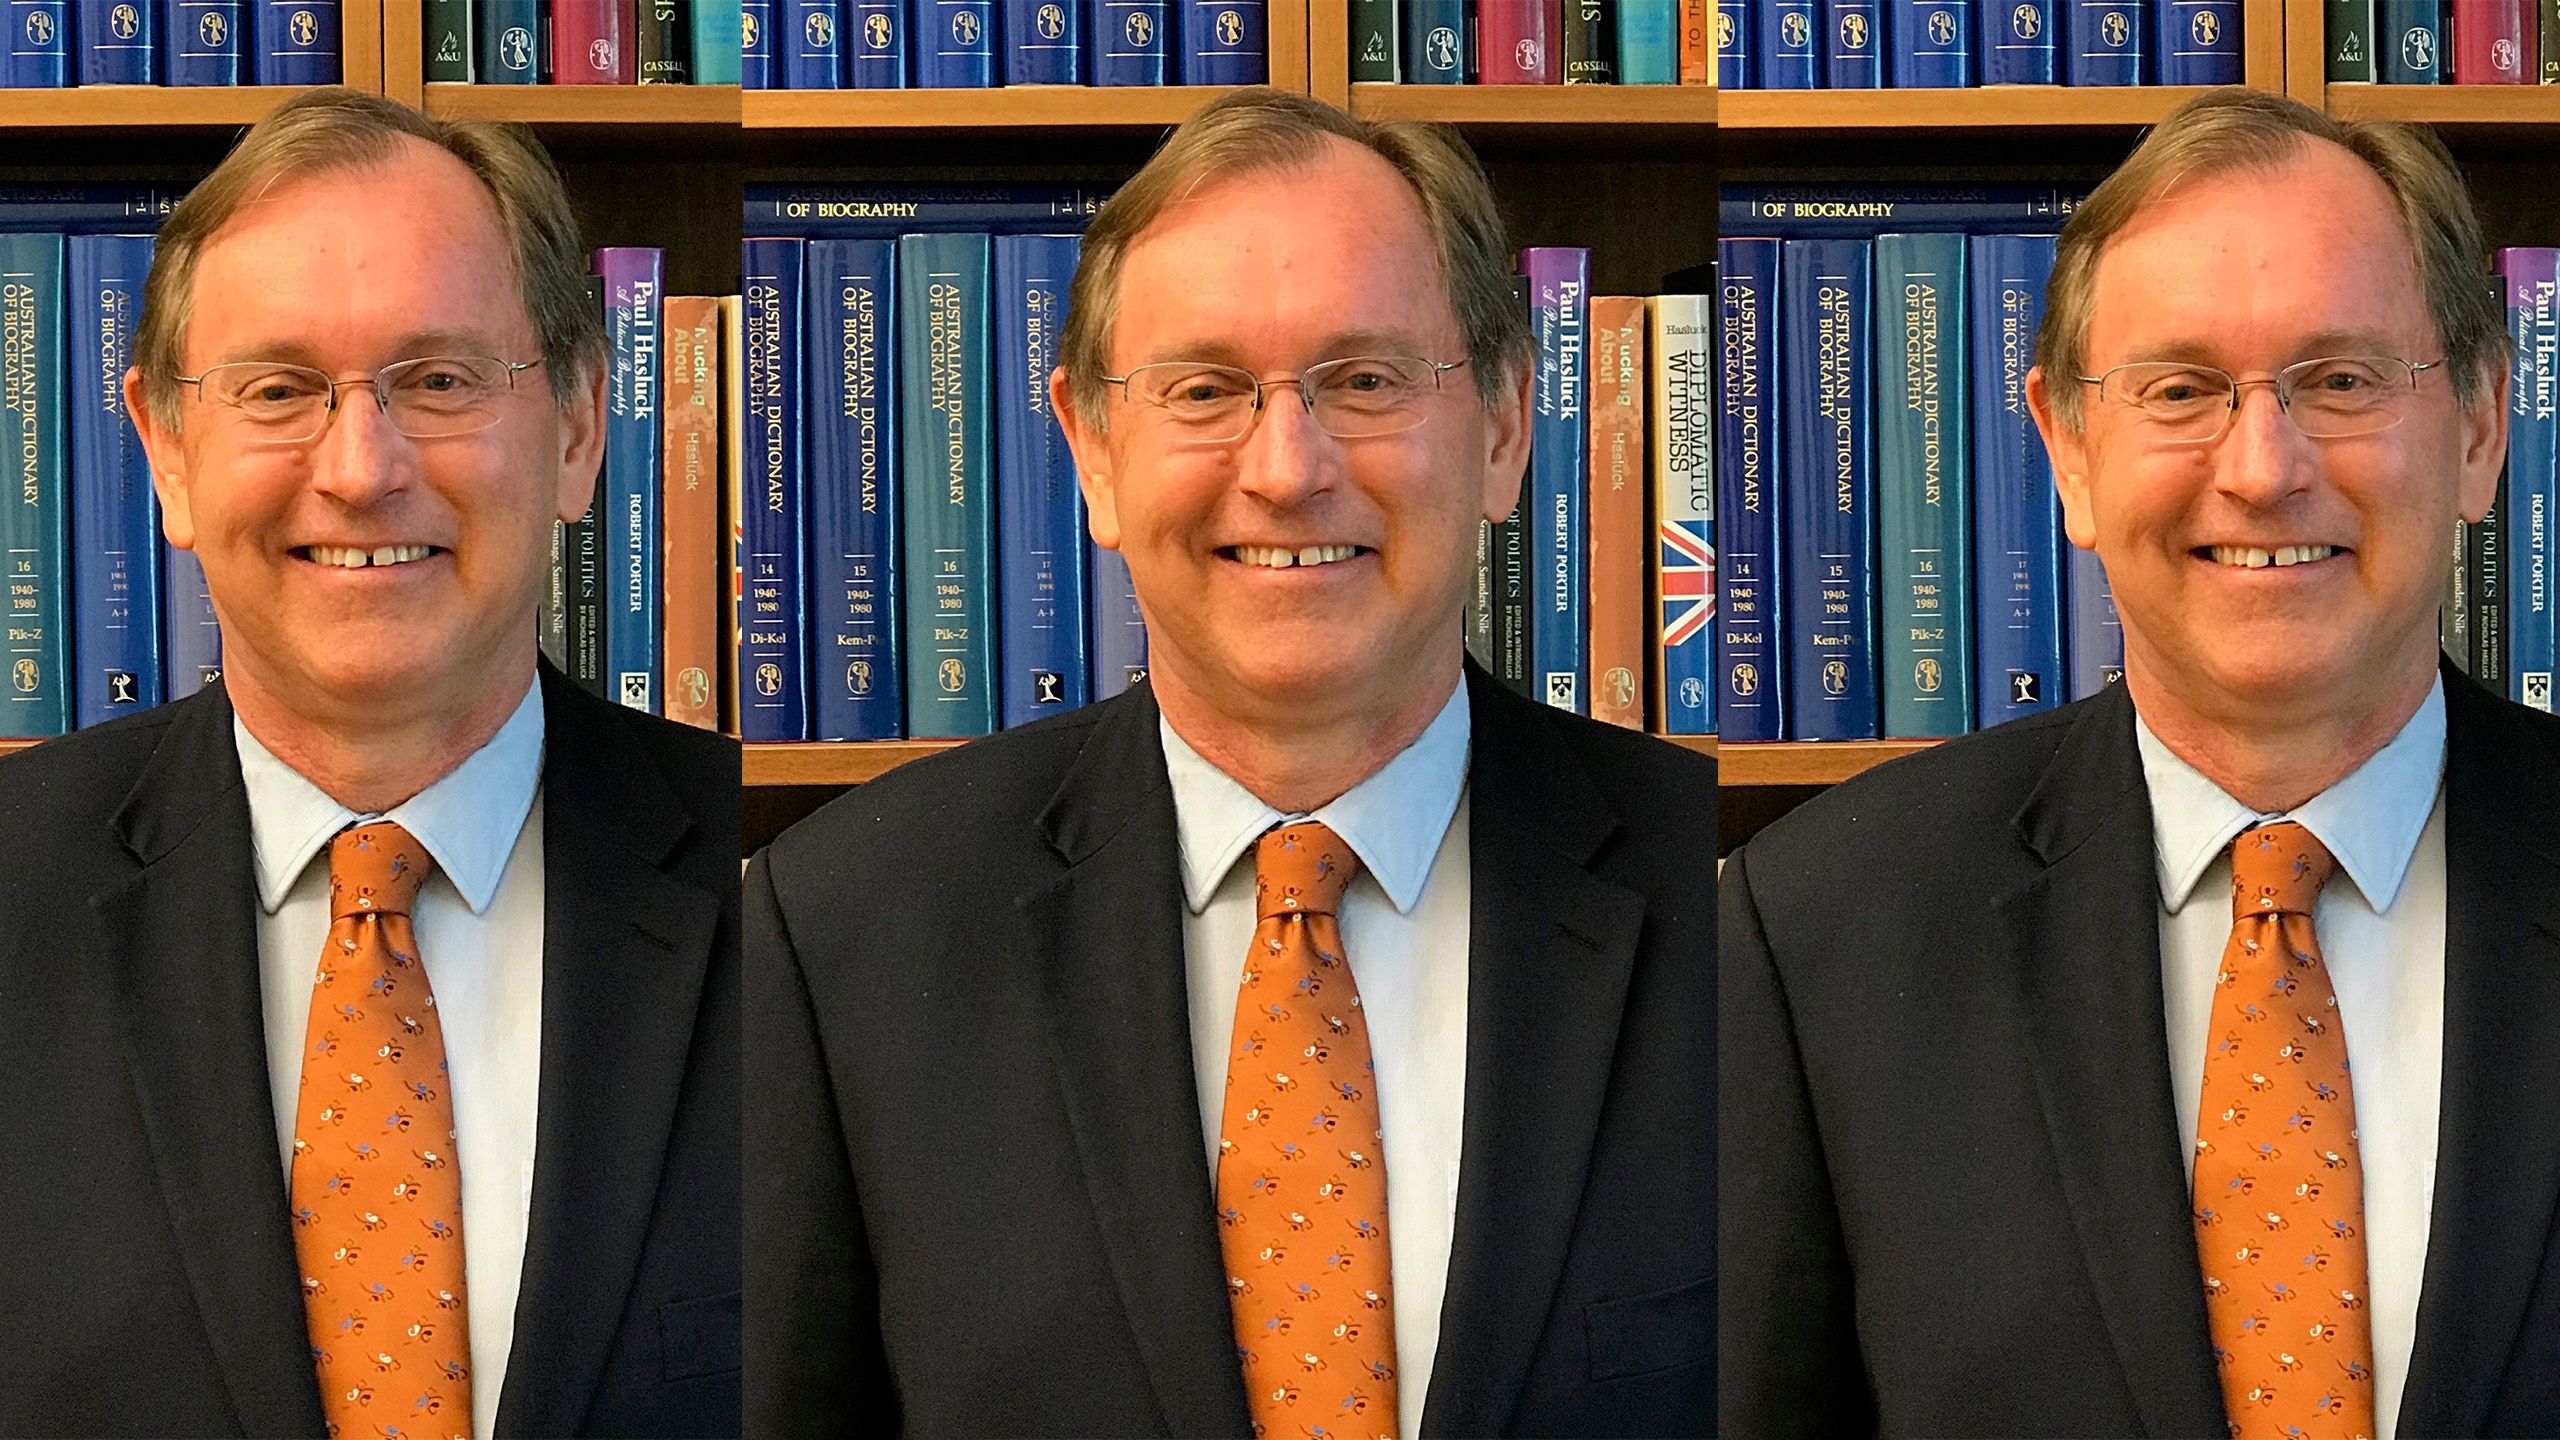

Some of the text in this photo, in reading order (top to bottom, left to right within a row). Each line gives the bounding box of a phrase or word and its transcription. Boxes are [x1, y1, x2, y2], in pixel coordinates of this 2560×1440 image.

[435, 51, 461, 62] A&U
[1361, 51, 1387, 62] A&U
[1689, 27, 1701, 50] TO
[2337, 51, 2363, 62] A&U
[786, 202, 918, 217] OF BIOGRAPHY
[1762, 202, 1894, 217] OF BIOGRAPHY
[3, 284, 20, 412] OF BIOGRAPHY
[100, 289, 116, 414] OF BIOGRAPHY
[612, 285, 632, 417] A Political Biography
[634, 280, 653, 421] Paul Hasluck
[674, 327, 690, 385] About
[748, 285, 765, 417] OF BIOGRAPHY
[842, 287, 858, 419] OF BIOGRAPHY
[929, 284, 946, 412] OF BIOGRAPHY
[1026, 289, 1042, 414] OF BIOGRAPHY
[1538, 285, 1558, 417] A Political Biography
[1560, 280, 1579, 421] Paul Hasluck
[1600, 327, 1616, 385] About
[1666, 324, 1709, 335] Hasluck
[1724, 285, 1741, 417] OF BIOGRAPHY
[1818, 287, 1834, 419] OF BIOGRAPHY
[1905, 284, 1922, 412] OF BIOGRAPHY
[2002, 289, 2018, 414] OF BIOGRAPHY
[2514, 285, 2534, 417] A Political Biography
[2536, 280, 2555, 421] Paul Hasluck
[20, 284, 38, 507] AUSTRALIAN DICTIONARY
[765, 286, 783, 514] AUSTRALIAN DICTIONARY
[859, 287, 876, 514] AUSTRALIAN DICTIONARY
[946, 284, 964, 507] AUSTRALIAN DICTIONARY
[1668, 350, 1689, 472] WITNESS
[1741, 286, 1759, 514] AUSTRALIAN DICTIONARY
[1835, 287, 1852, 514] AUSTRALIAN DICTIONARY
[1922, 284, 1940, 507] AUSTRALIAN DICTIONARY
[686, 432, 700, 491] Hasluck
[1612, 432, 1626, 491] Hasluck
[1689, 349, 1709, 512] DIPLOMATIC
[17, 561, 31, 572] 16
[581, 531, 595, 598] POLITICS
[630, 493, 642, 613] ROBERT PORTER
[760, 563, 774, 575] 14
[853, 565, 867, 576] 15
[943, 561, 957, 572] 16
[1507, 531, 1521, 598] POLITICS
[1556, 493, 1568, 613] ROBERT PORTER
[1736, 563, 1750, 575] 14
[1829, 565, 1843, 576] 15
[1919, 561, 1933, 572] 16
[2483, 531, 2497, 598] POLITICS
[2532, 493, 2544, 613] ROBERT PORTER
[13, 599, 36, 609] 1980
[553, 613, 563, 634] Nile
[588, 605, 596, 629] EDITED
[756, 601, 779, 612] 1980
[849, 603, 873, 614] 1980
[939, 599, 962, 609] 1980
[1479, 613, 1489, 634] Nile
[1514, 605, 1522, 629] EDITED
[1732, 601, 1755, 612] 1980
[1825, 603, 1849, 614] 1980
[1915, 599, 1938, 609] 1980
[2455, 613, 2465, 634] Nile
[2490, 605, 2498, 629] EDITED
[579, 605, 587, 680] BY NICHOLAS HASLUCK
[588, 636, 596, 680] INTRODUCED
[1505, 605, 1513, 680] BY NICHOLAS HASLUCK
[1514, 636, 1522, 680] INTRODUCED
[2481, 605, 2489, 680] BY NICHOLAS HASLUCK
[2490, 636, 2498, 680] INTRODUCED
